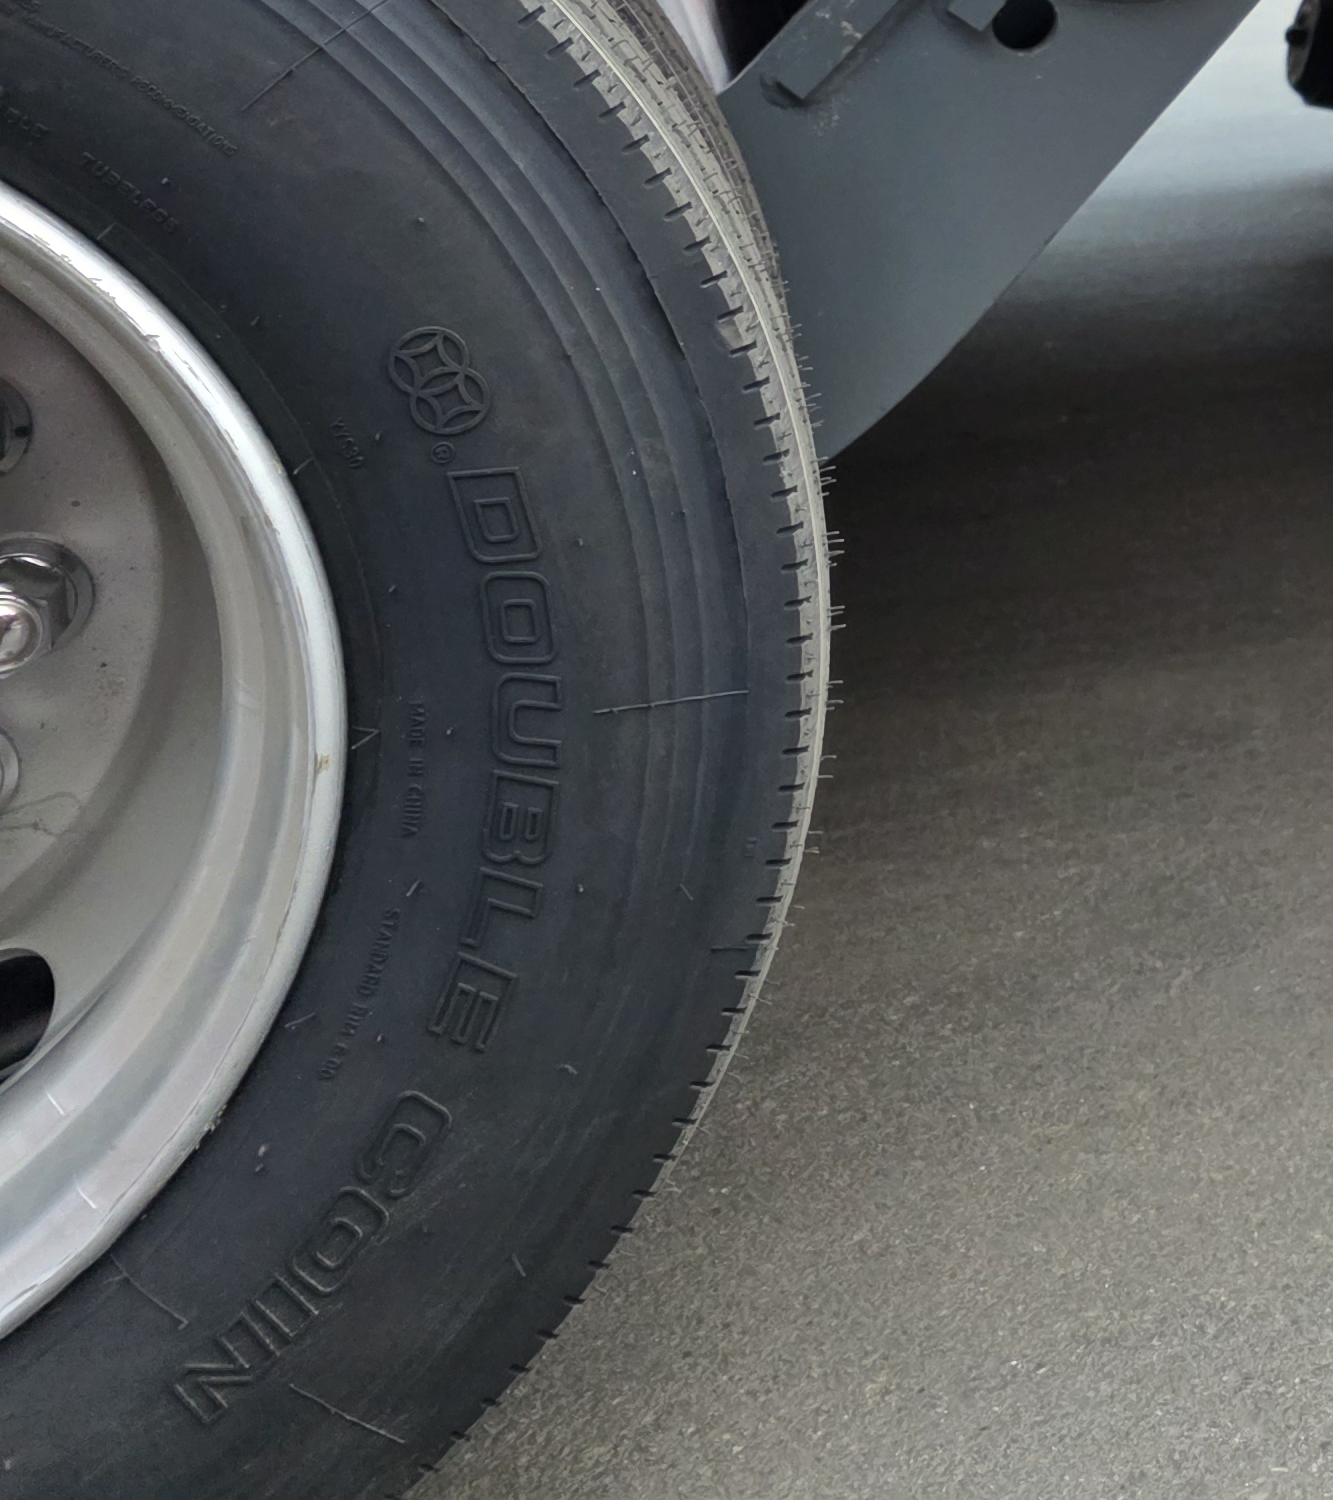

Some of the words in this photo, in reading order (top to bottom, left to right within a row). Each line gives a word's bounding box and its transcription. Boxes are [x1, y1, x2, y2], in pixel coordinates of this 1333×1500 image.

[407, 700, 426, 749] MADE
[407, 757, 425, 777] IN
[430, 466, 562, 1051] DOUBLE
[400, 783, 425, 839] CHINA
[174, 1092, 452, 1425] COIN
